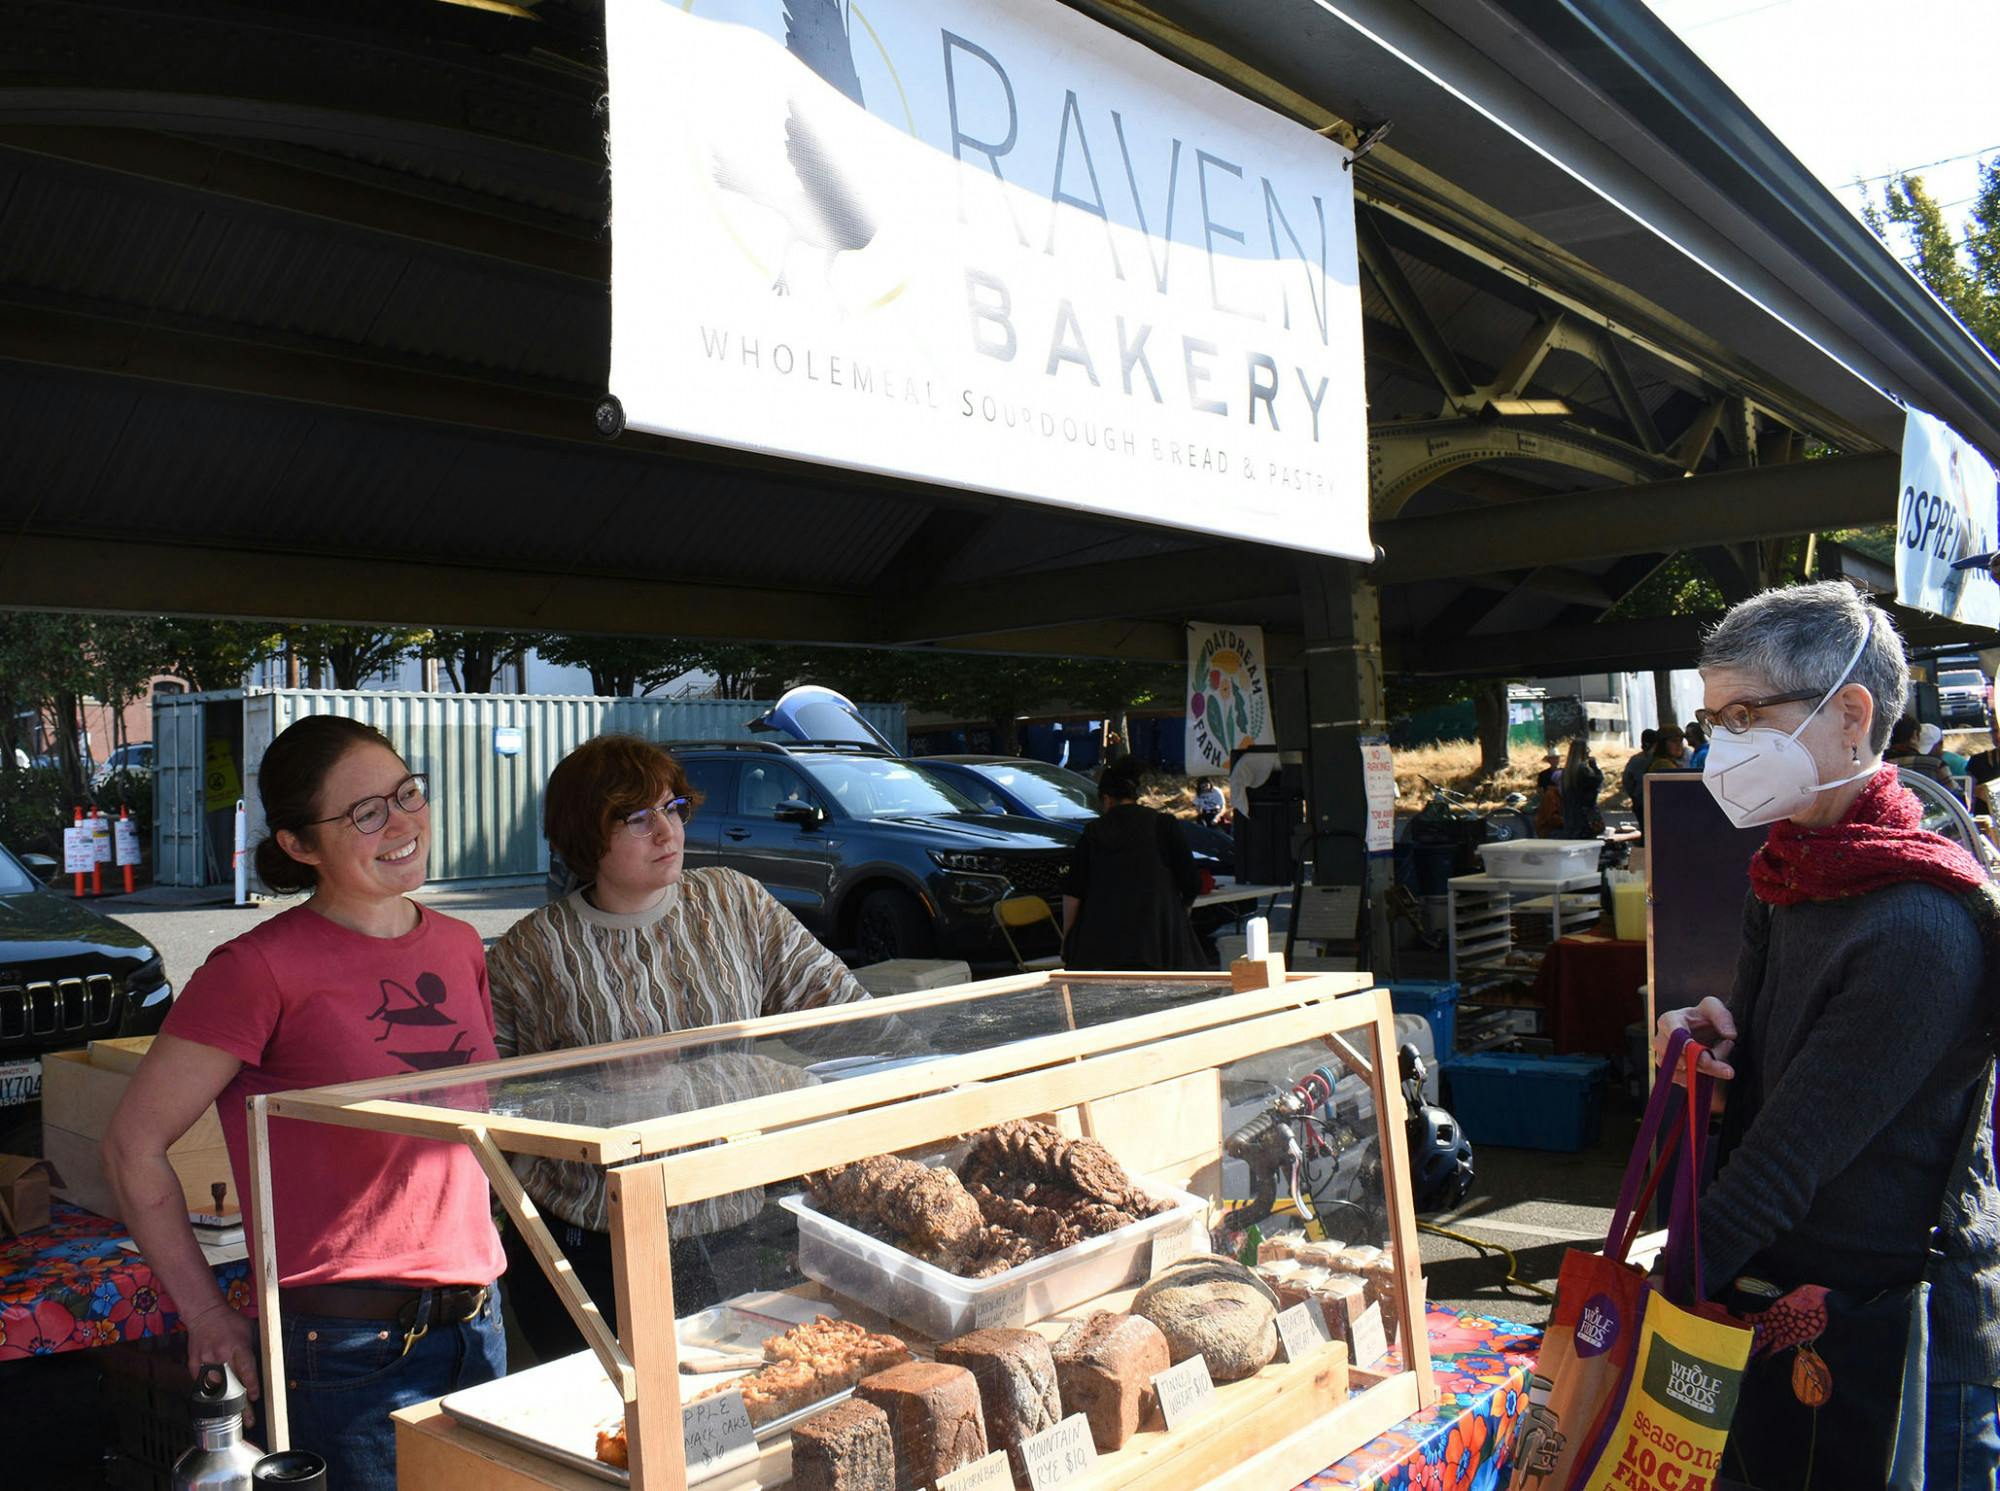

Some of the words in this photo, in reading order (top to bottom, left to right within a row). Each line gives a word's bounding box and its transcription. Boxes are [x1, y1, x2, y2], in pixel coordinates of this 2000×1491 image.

[941, 28, 1329, 346] RAVEN
[965, 267, 1329, 443] BAKERY
[700, 325, 938, 409] WHOLEMEAL
[961, 390, 1135, 456] SOURDOUGH
[1151, 436, 1228, 474] BREAD
[1244, 456, 1256, 481] &
[1204, 629, 1263, 695] DAYDREAM
[1193, 719, 1223, 769] FARM
[1668, 1375, 1716, 1406] FOODS
[1671, 1360, 1722, 1393] WHOLE
[685, 1397, 730, 1428] PPLE
[685, 1427, 718, 1451] NACK
[722, 1415, 749, 1435] CAKE
[1029, 1421, 1081, 1462] MOUNTAIN
[1037, 1460, 1062, 1489] RYE
[1612, 1461, 1662, 1491] FAR
